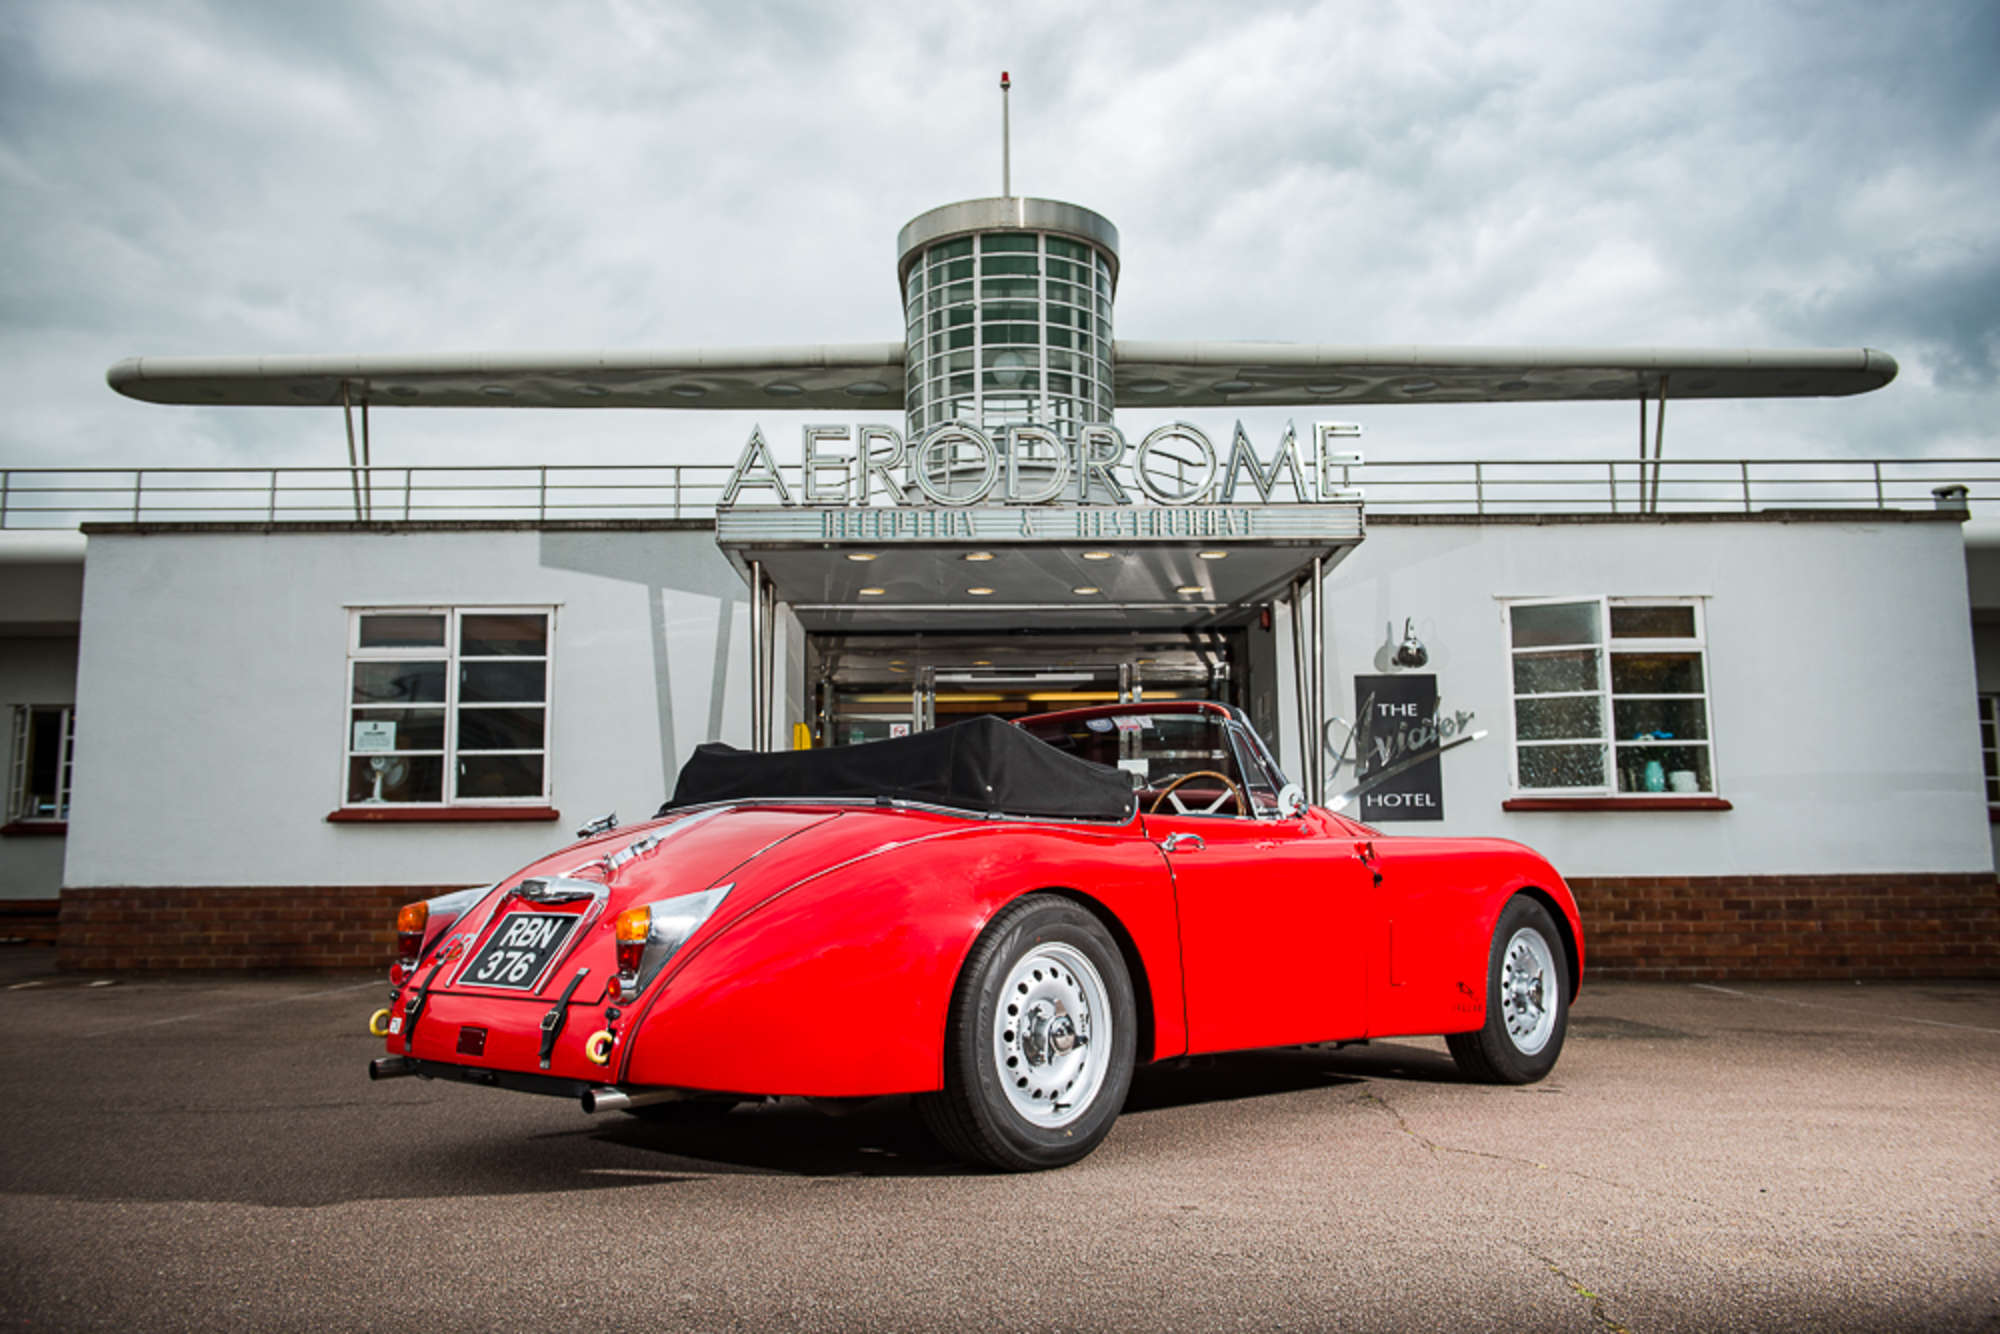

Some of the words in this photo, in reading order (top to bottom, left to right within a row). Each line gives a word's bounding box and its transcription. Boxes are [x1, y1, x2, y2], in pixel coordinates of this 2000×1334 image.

[715, 419, 1365, 506] AERODROME
[1377, 703, 1418, 717] THE
[1325, 691, 1475, 791] Aviator
[1366, 793, 1436, 808] HOTEL
[499, 917, 564, 949] RBN
[476, 950, 537, 983] 376
